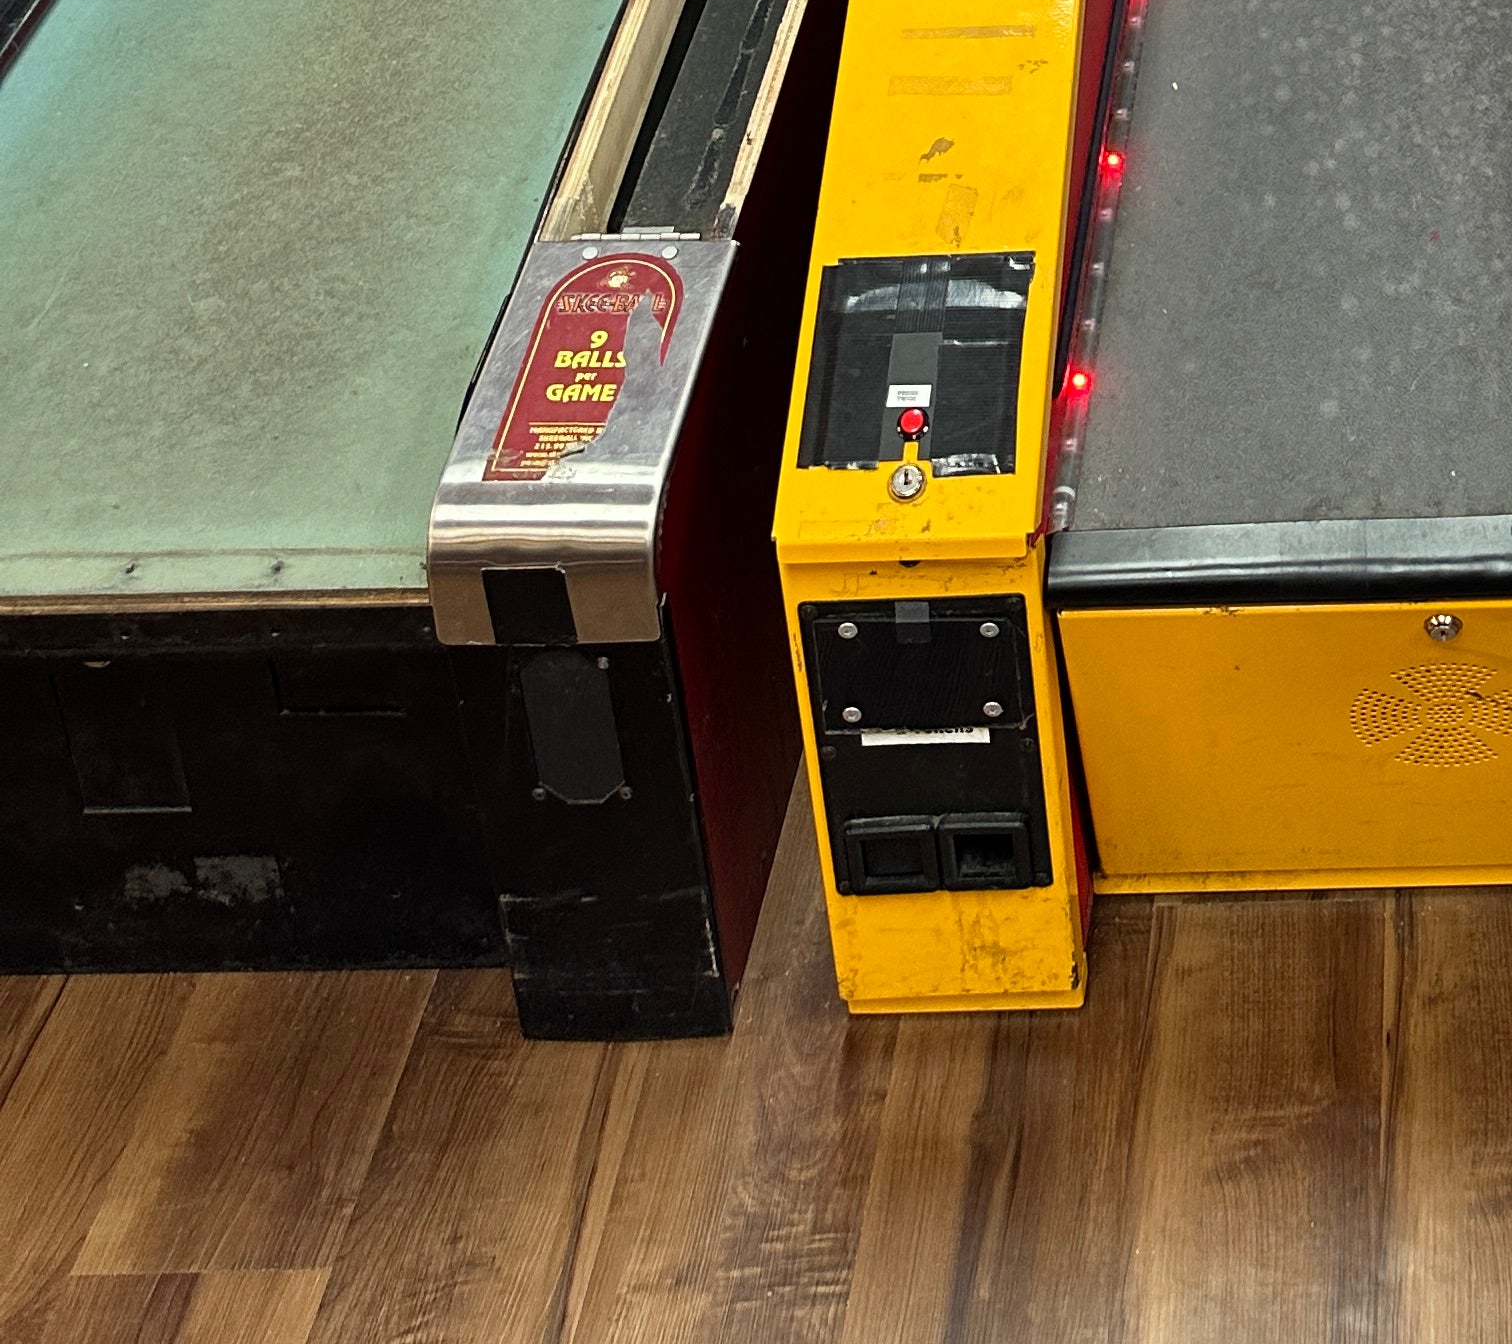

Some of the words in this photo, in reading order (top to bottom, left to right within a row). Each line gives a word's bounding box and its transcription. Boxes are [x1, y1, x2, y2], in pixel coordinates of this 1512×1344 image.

[590, 330, 609, 350] 9
[554, 350, 627, 369] BALLS
[574, 371, 598, 383] per
[545, 383, 618, 403] GAME
